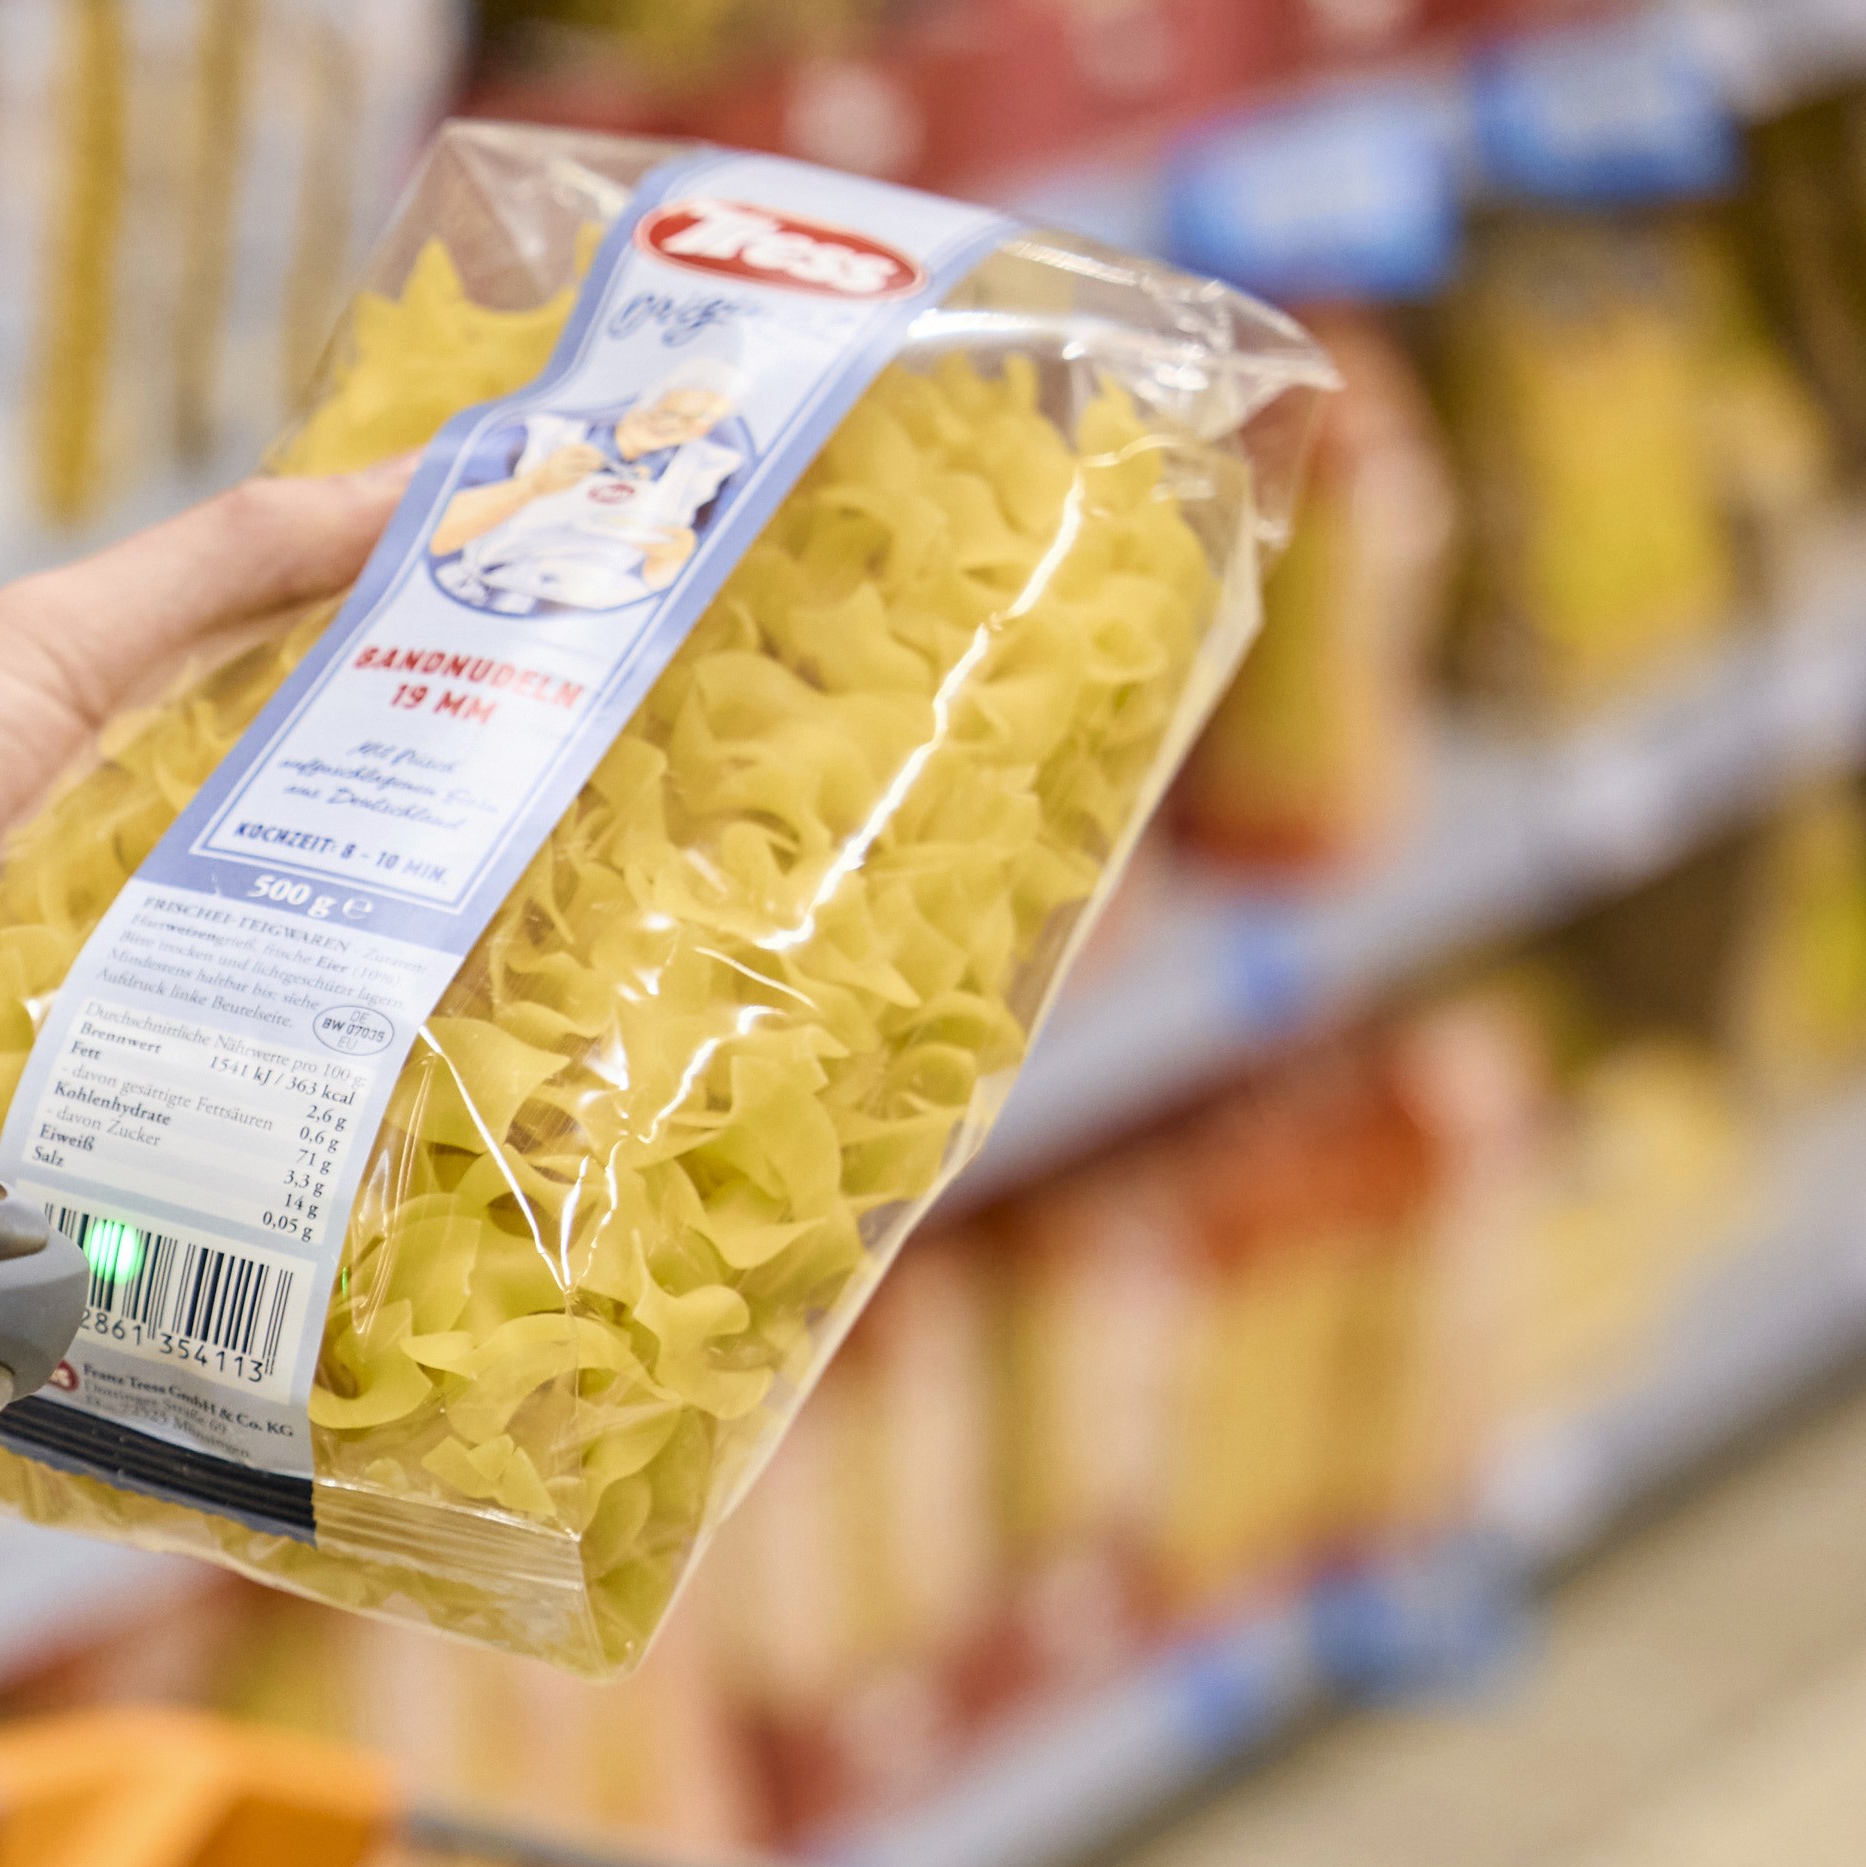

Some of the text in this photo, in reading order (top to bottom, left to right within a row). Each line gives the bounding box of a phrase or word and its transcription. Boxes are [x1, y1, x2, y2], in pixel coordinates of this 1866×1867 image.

[662, 212, 897, 293] Tress
[353, 645, 585, 709] BANDNUDELN
[389, 683, 499, 724] 19 MM
[234, 820, 339, 856] KOCHZEIT:
[375, 851, 400, 870] 10
[402, 860, 447, 885] MIN.
[144, 896, 349, 952] FRISCHEI-TEIGWAREN
[246, 873, 312, 907] 500
[307, 888, 338, 920] g
[107, 947, 193, 980] Mindestens
[195, 968, 251, 995] haltbar
[282, 988, 320, 1011] siehe
[217, 951, 249, 972] und
[316, 955, 350, 975] Eier
[97, 966, 294, 1031] Aufdruck linke Beutelseite.
[322, 1017, 345, 1035] BW
[349, 1010, 371, 1025] DE
[78, 1021, 164, 1056] Brennwert
[209, 1055, 251, 1079] 1541
[251, 1065, 272, 1088] kJ
[285, 1075, 320, 1098] 363
[319, 1083, 356, 1107] kcal
[84, 1000, 212, 1049] Durchschnittliche
[214, 1032, 291, 1070] Nährwerte
[292, 1057, 321, 1077] pro
[323, 1061, 350, 1082] 100
[336, 1036, 358, 1051] EU
[70, 1041, 348, 1133] Fett 2,6 g
[71, 1063, 118, 1091] davon
[120, 1076, 193, 1113] gesättigte
[195, 1096, 274, 1132] Fettsäuren
[298, 1123, 330, 1146] 0,6
[328, 1136, 341, 1154] g
[53, 1080, 334, 1176] Kohlenhydrate 71 g
[56, 1104, 102, 1132] davon
[106, 1117, 163, 1148] Zucker
[282, 1168, 312, 1190] 3,3
[312, 1180, 326, 1198] g
[30, 1145, 314, 1244] Salz 0,05 g
[38, 1123, 320, 1220] Eiweiß 14 g
[160, 1332, 265, 1384] 354113
[83, 1363, 126, 1386] Franz
[129, 1375, 166, 1396] Tress
[168, 1384, 218, 1415] GmbH
[219, 1407, 235, 1423] &
[236, 1414, 263, 1431] Co.
[266, 1421, 295, 1439] KG
